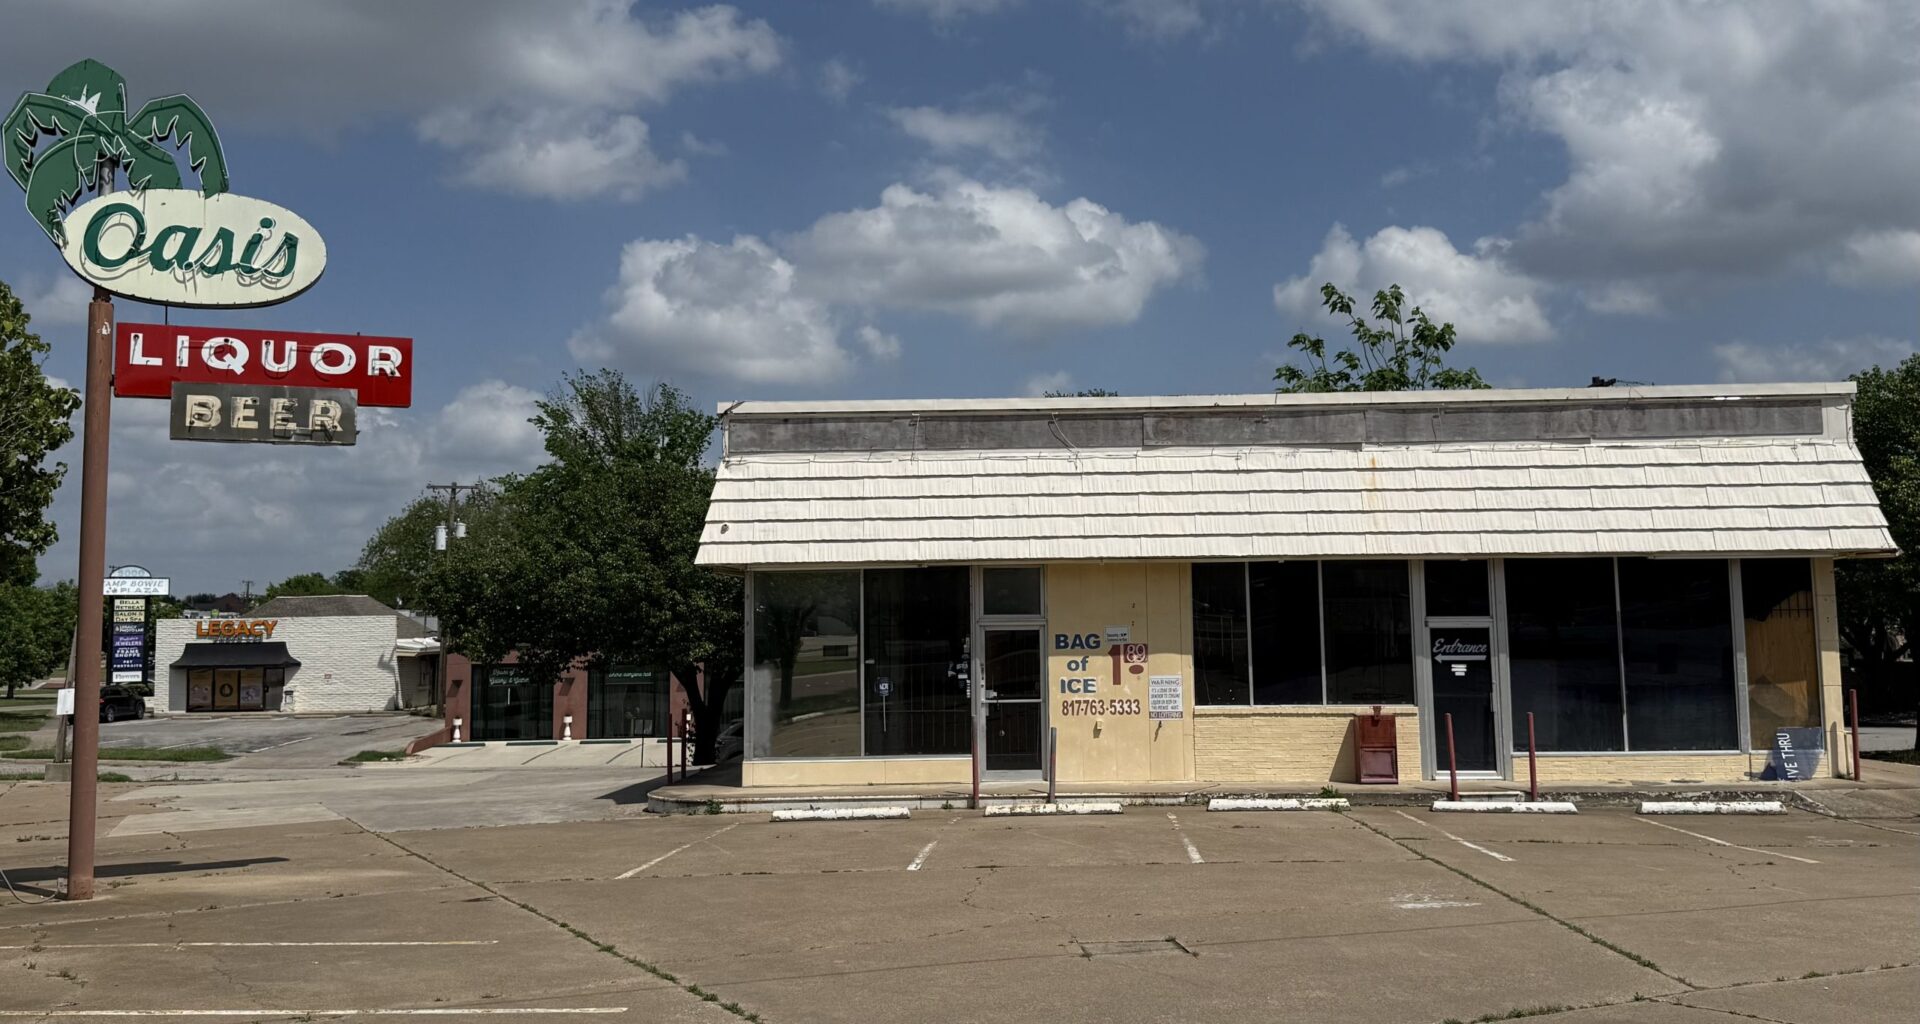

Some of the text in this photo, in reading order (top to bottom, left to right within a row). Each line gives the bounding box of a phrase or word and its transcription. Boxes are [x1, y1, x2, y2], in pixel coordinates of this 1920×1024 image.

[83, 202, 299, 278] Oasis
[129, 333, 402, 377] LIQUOR
[185, 394, 344, 433] BEER
[131, 580, 164, 588] BOWIE
[196, 619, 279, 639] LEGACY
[1055, 633, 1101, 650] BAG
[1432, 637, 1487, 653] Entrance
[1067, 655, 1089, 672] of
[1107, 644, 1121, 686] 1
[1060, 678, 1097, 694] ICE
[1776, 733, 1794, 759] THRU
